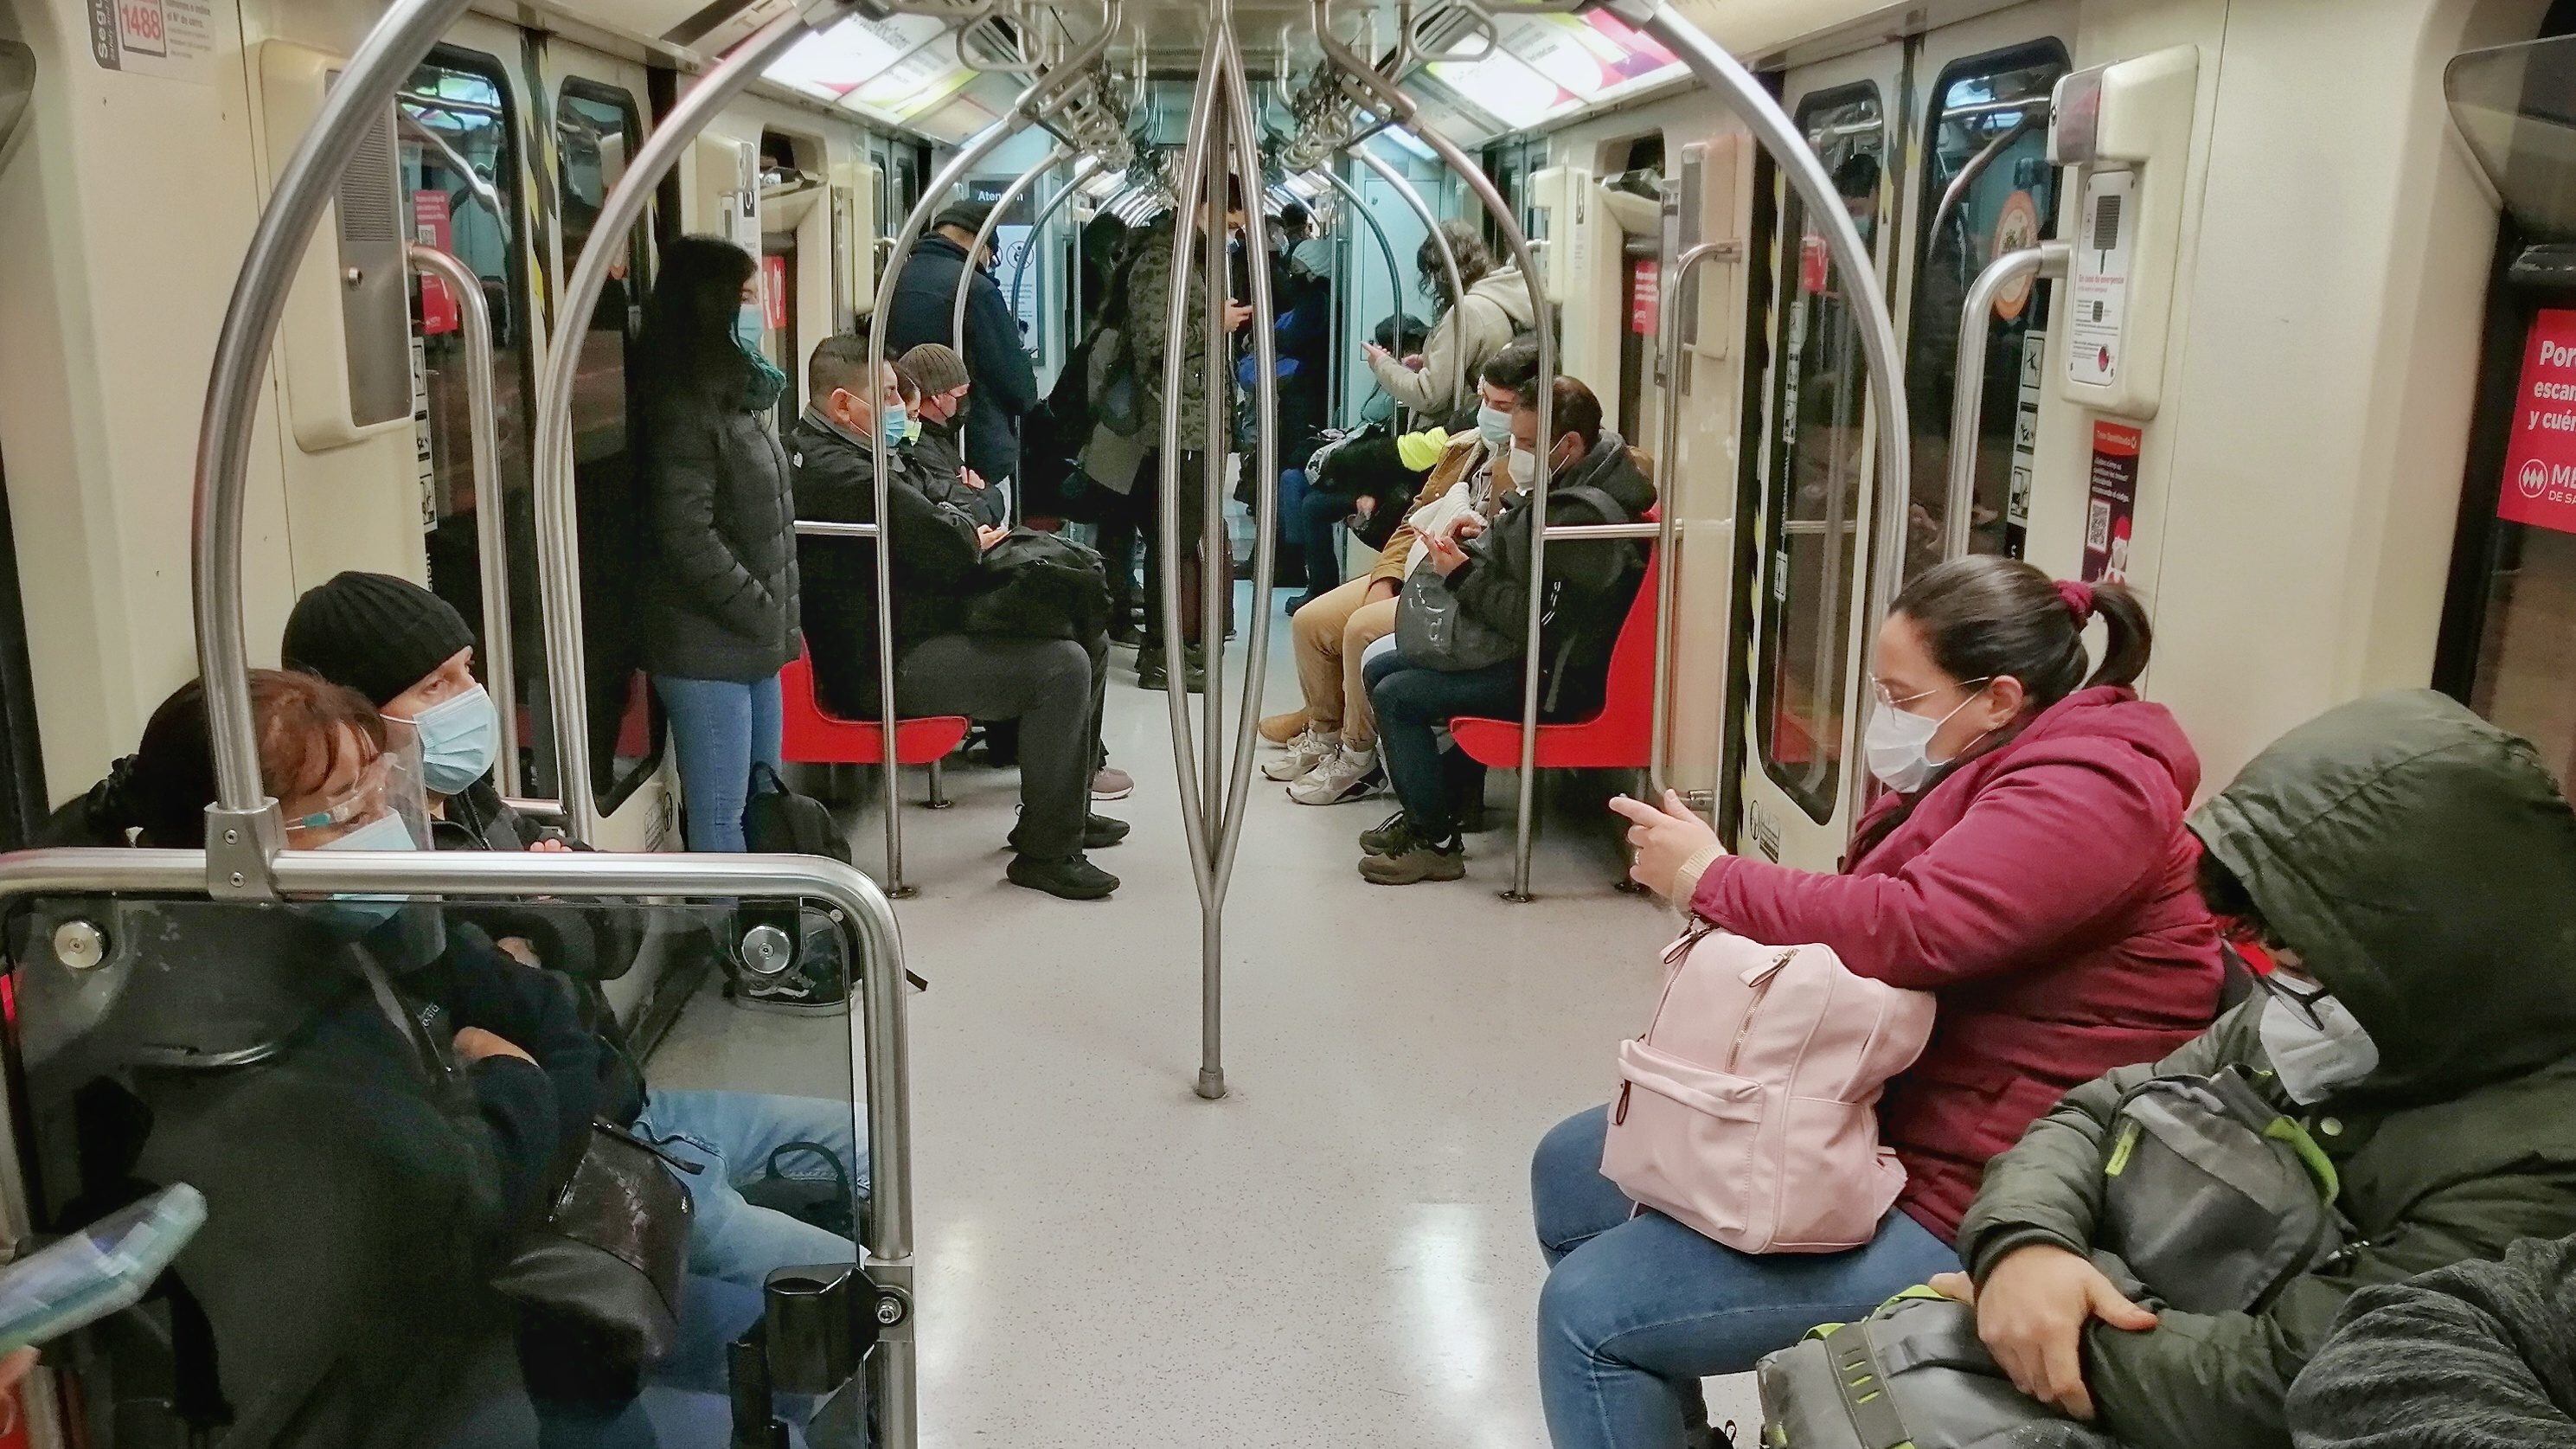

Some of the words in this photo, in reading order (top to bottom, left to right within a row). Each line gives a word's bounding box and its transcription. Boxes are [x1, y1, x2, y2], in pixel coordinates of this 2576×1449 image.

[122, 3, 161, 41] 1488
[977, 189, 1024, 201] Atenn
[2528, 411, 2541, 430] y
[2548, 490, 2564, 502] DE
